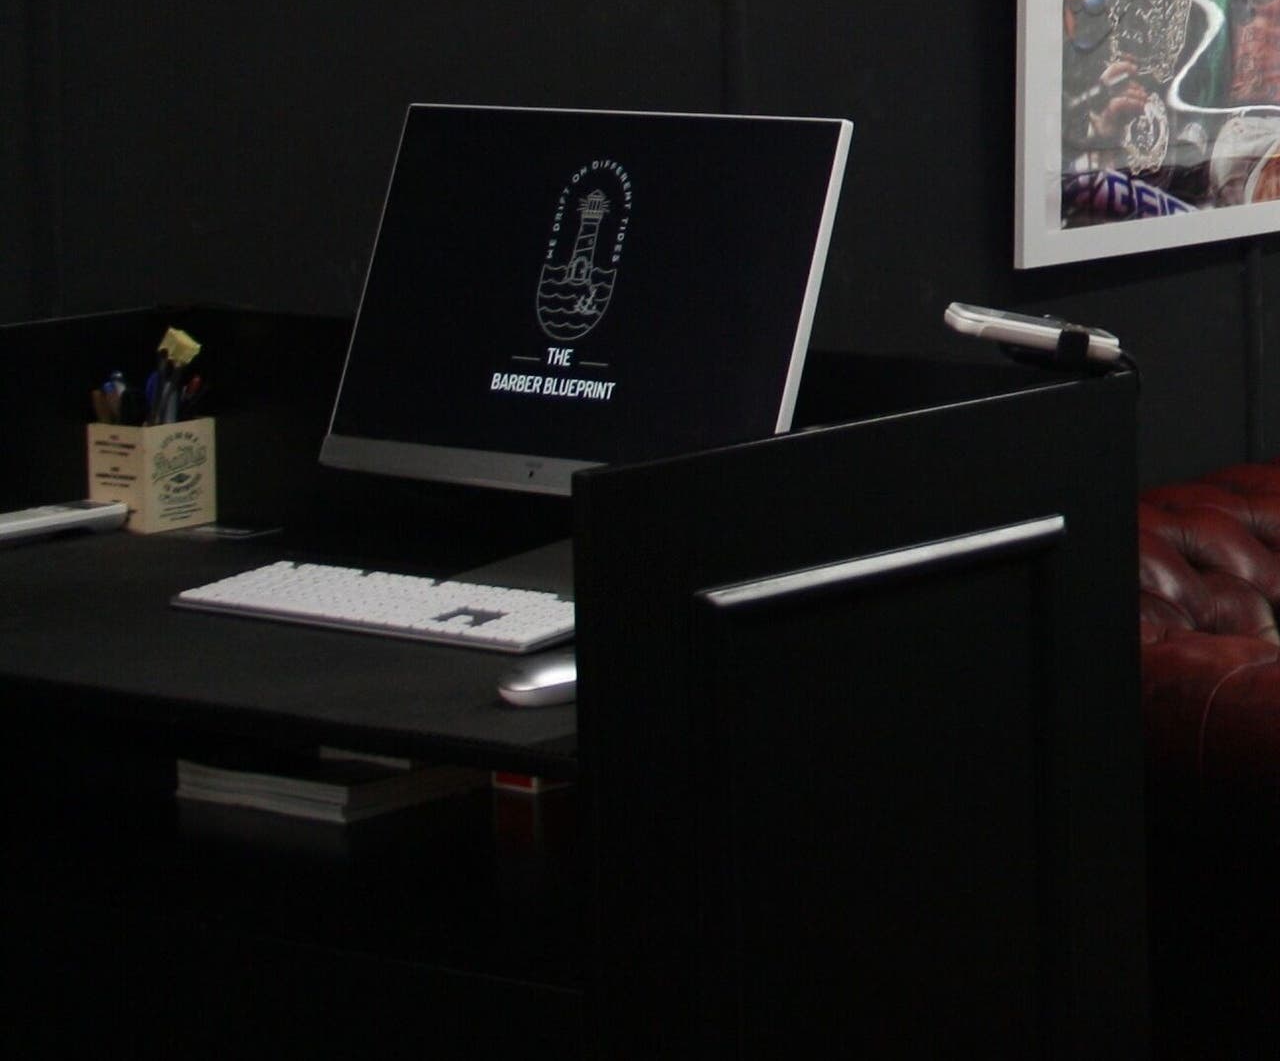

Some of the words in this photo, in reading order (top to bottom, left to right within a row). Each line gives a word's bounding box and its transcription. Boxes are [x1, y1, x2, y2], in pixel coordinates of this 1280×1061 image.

[547, 347, 574, 366] THE
[490, 372, 542, 393] BARBER
[543, 377, 616, 400] BLUEPRINT
